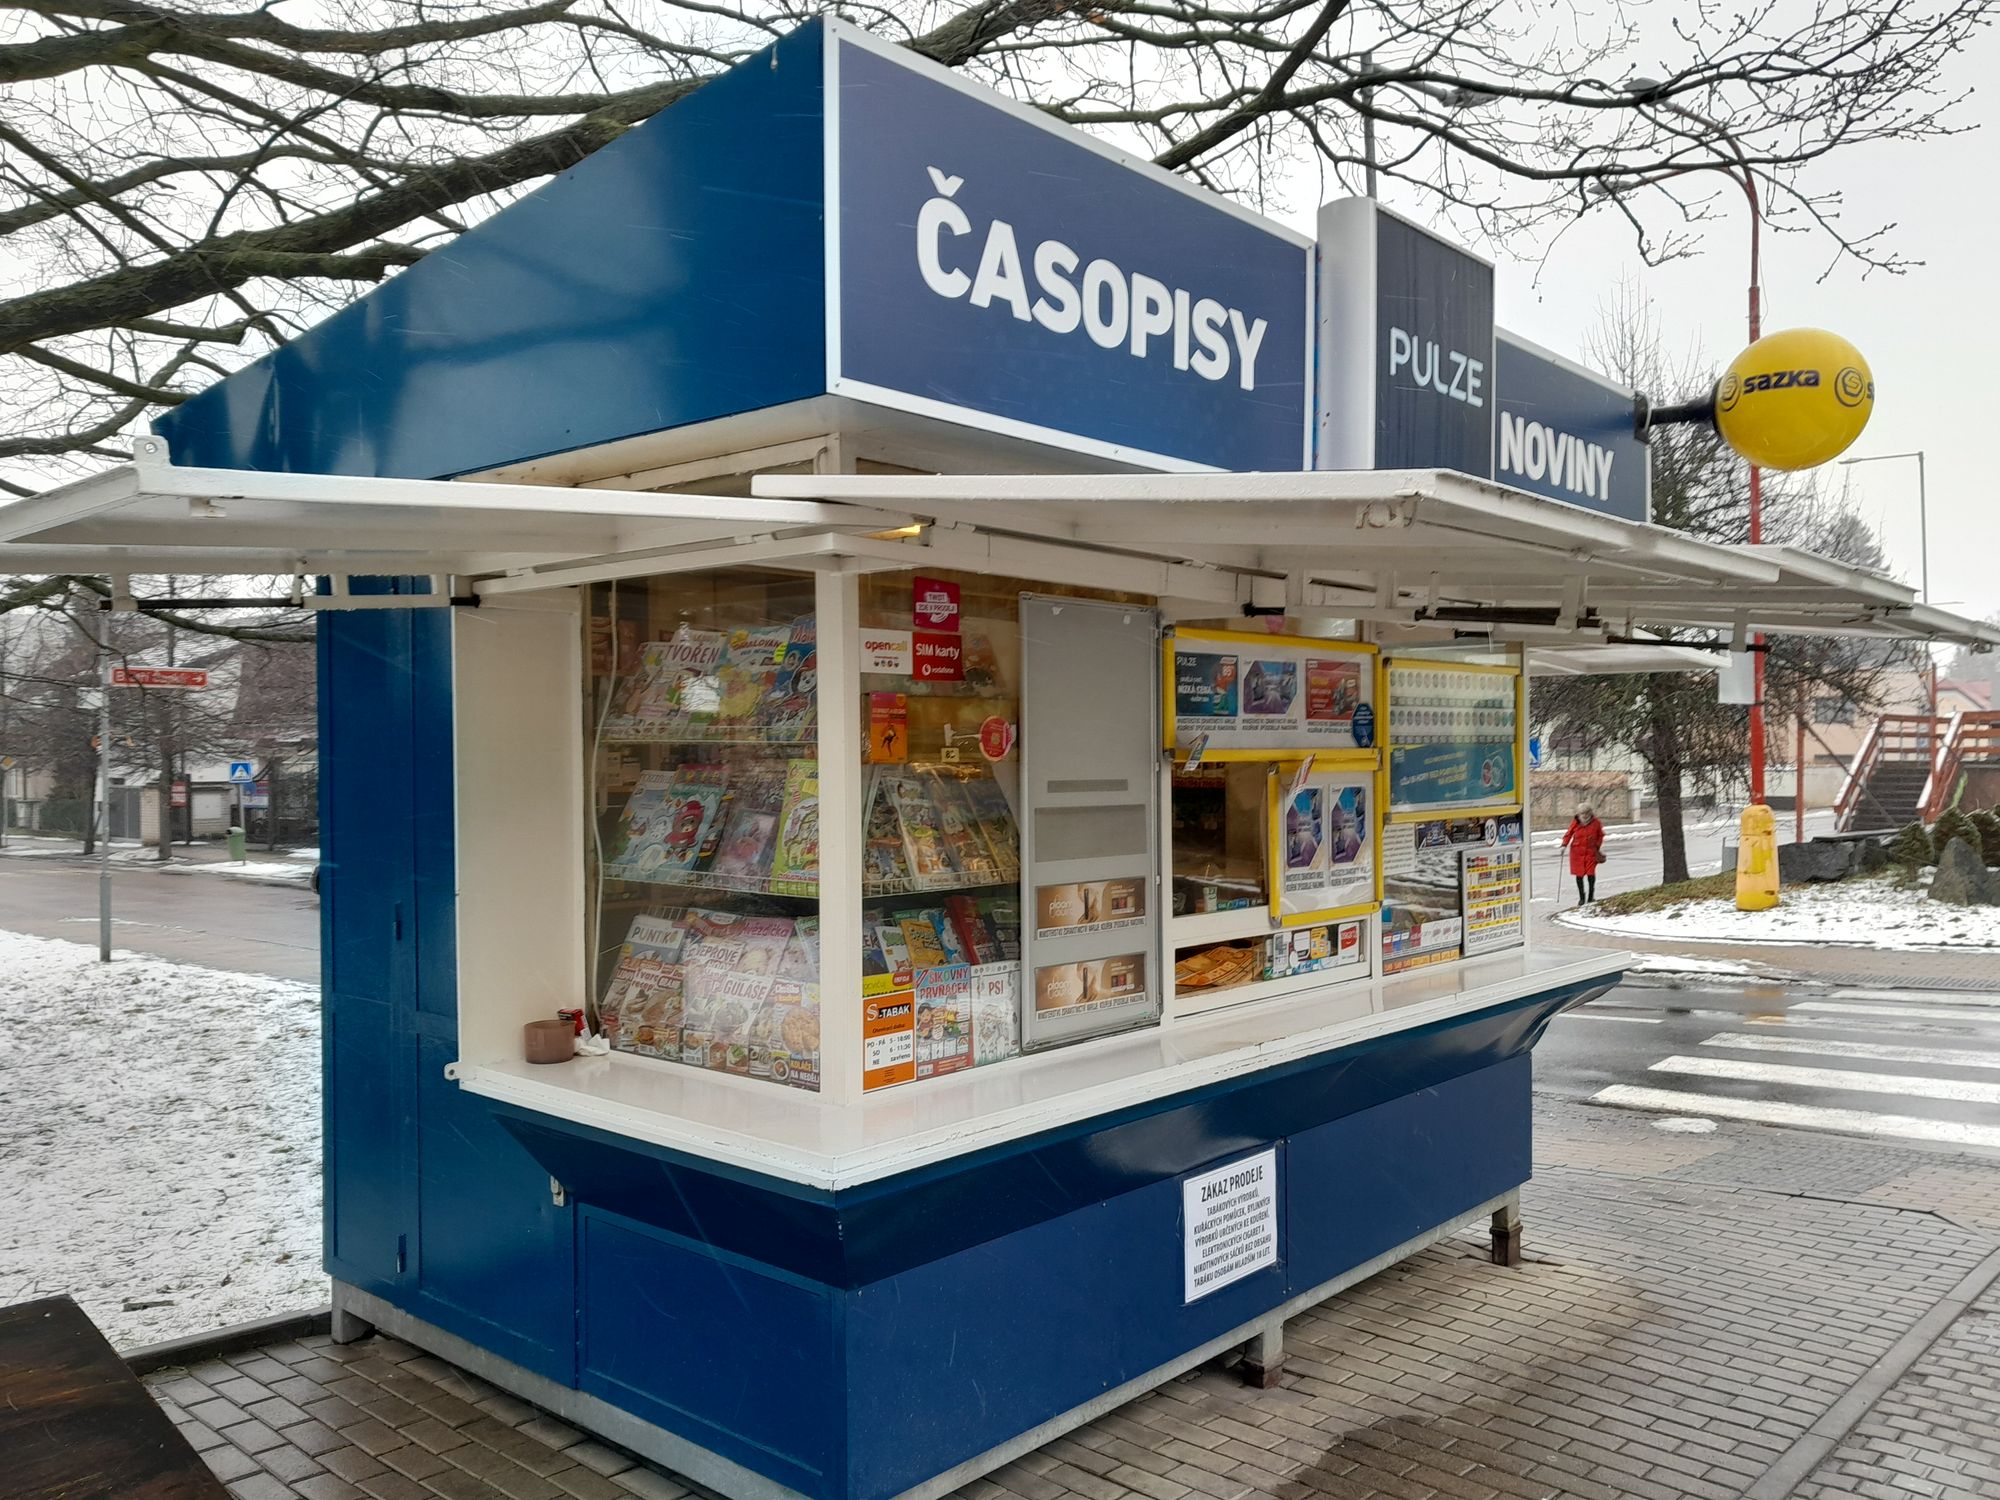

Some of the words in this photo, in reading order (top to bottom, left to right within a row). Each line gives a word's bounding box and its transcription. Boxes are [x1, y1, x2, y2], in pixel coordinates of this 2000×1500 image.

[916, 165, 1269, 393] ČASOPISY
[1388, 326, 1485, 409] PULZE
[1742, 368, 1821, 395] sazka
[1499, 410, 1615, 503] NOVINY
[865, 640, 907, 652] opencall
[915, 643, 934, 656] SIM
[935, 645, 960, 661] karty
[724, 979, 768, 1000] GULÁŠE
[988, 980, 1004, 996] PSI
[1201, 1178, 1228, 1202] ZÁKAZ
[1229, 1165, 1263, 1191] PRODEJE
